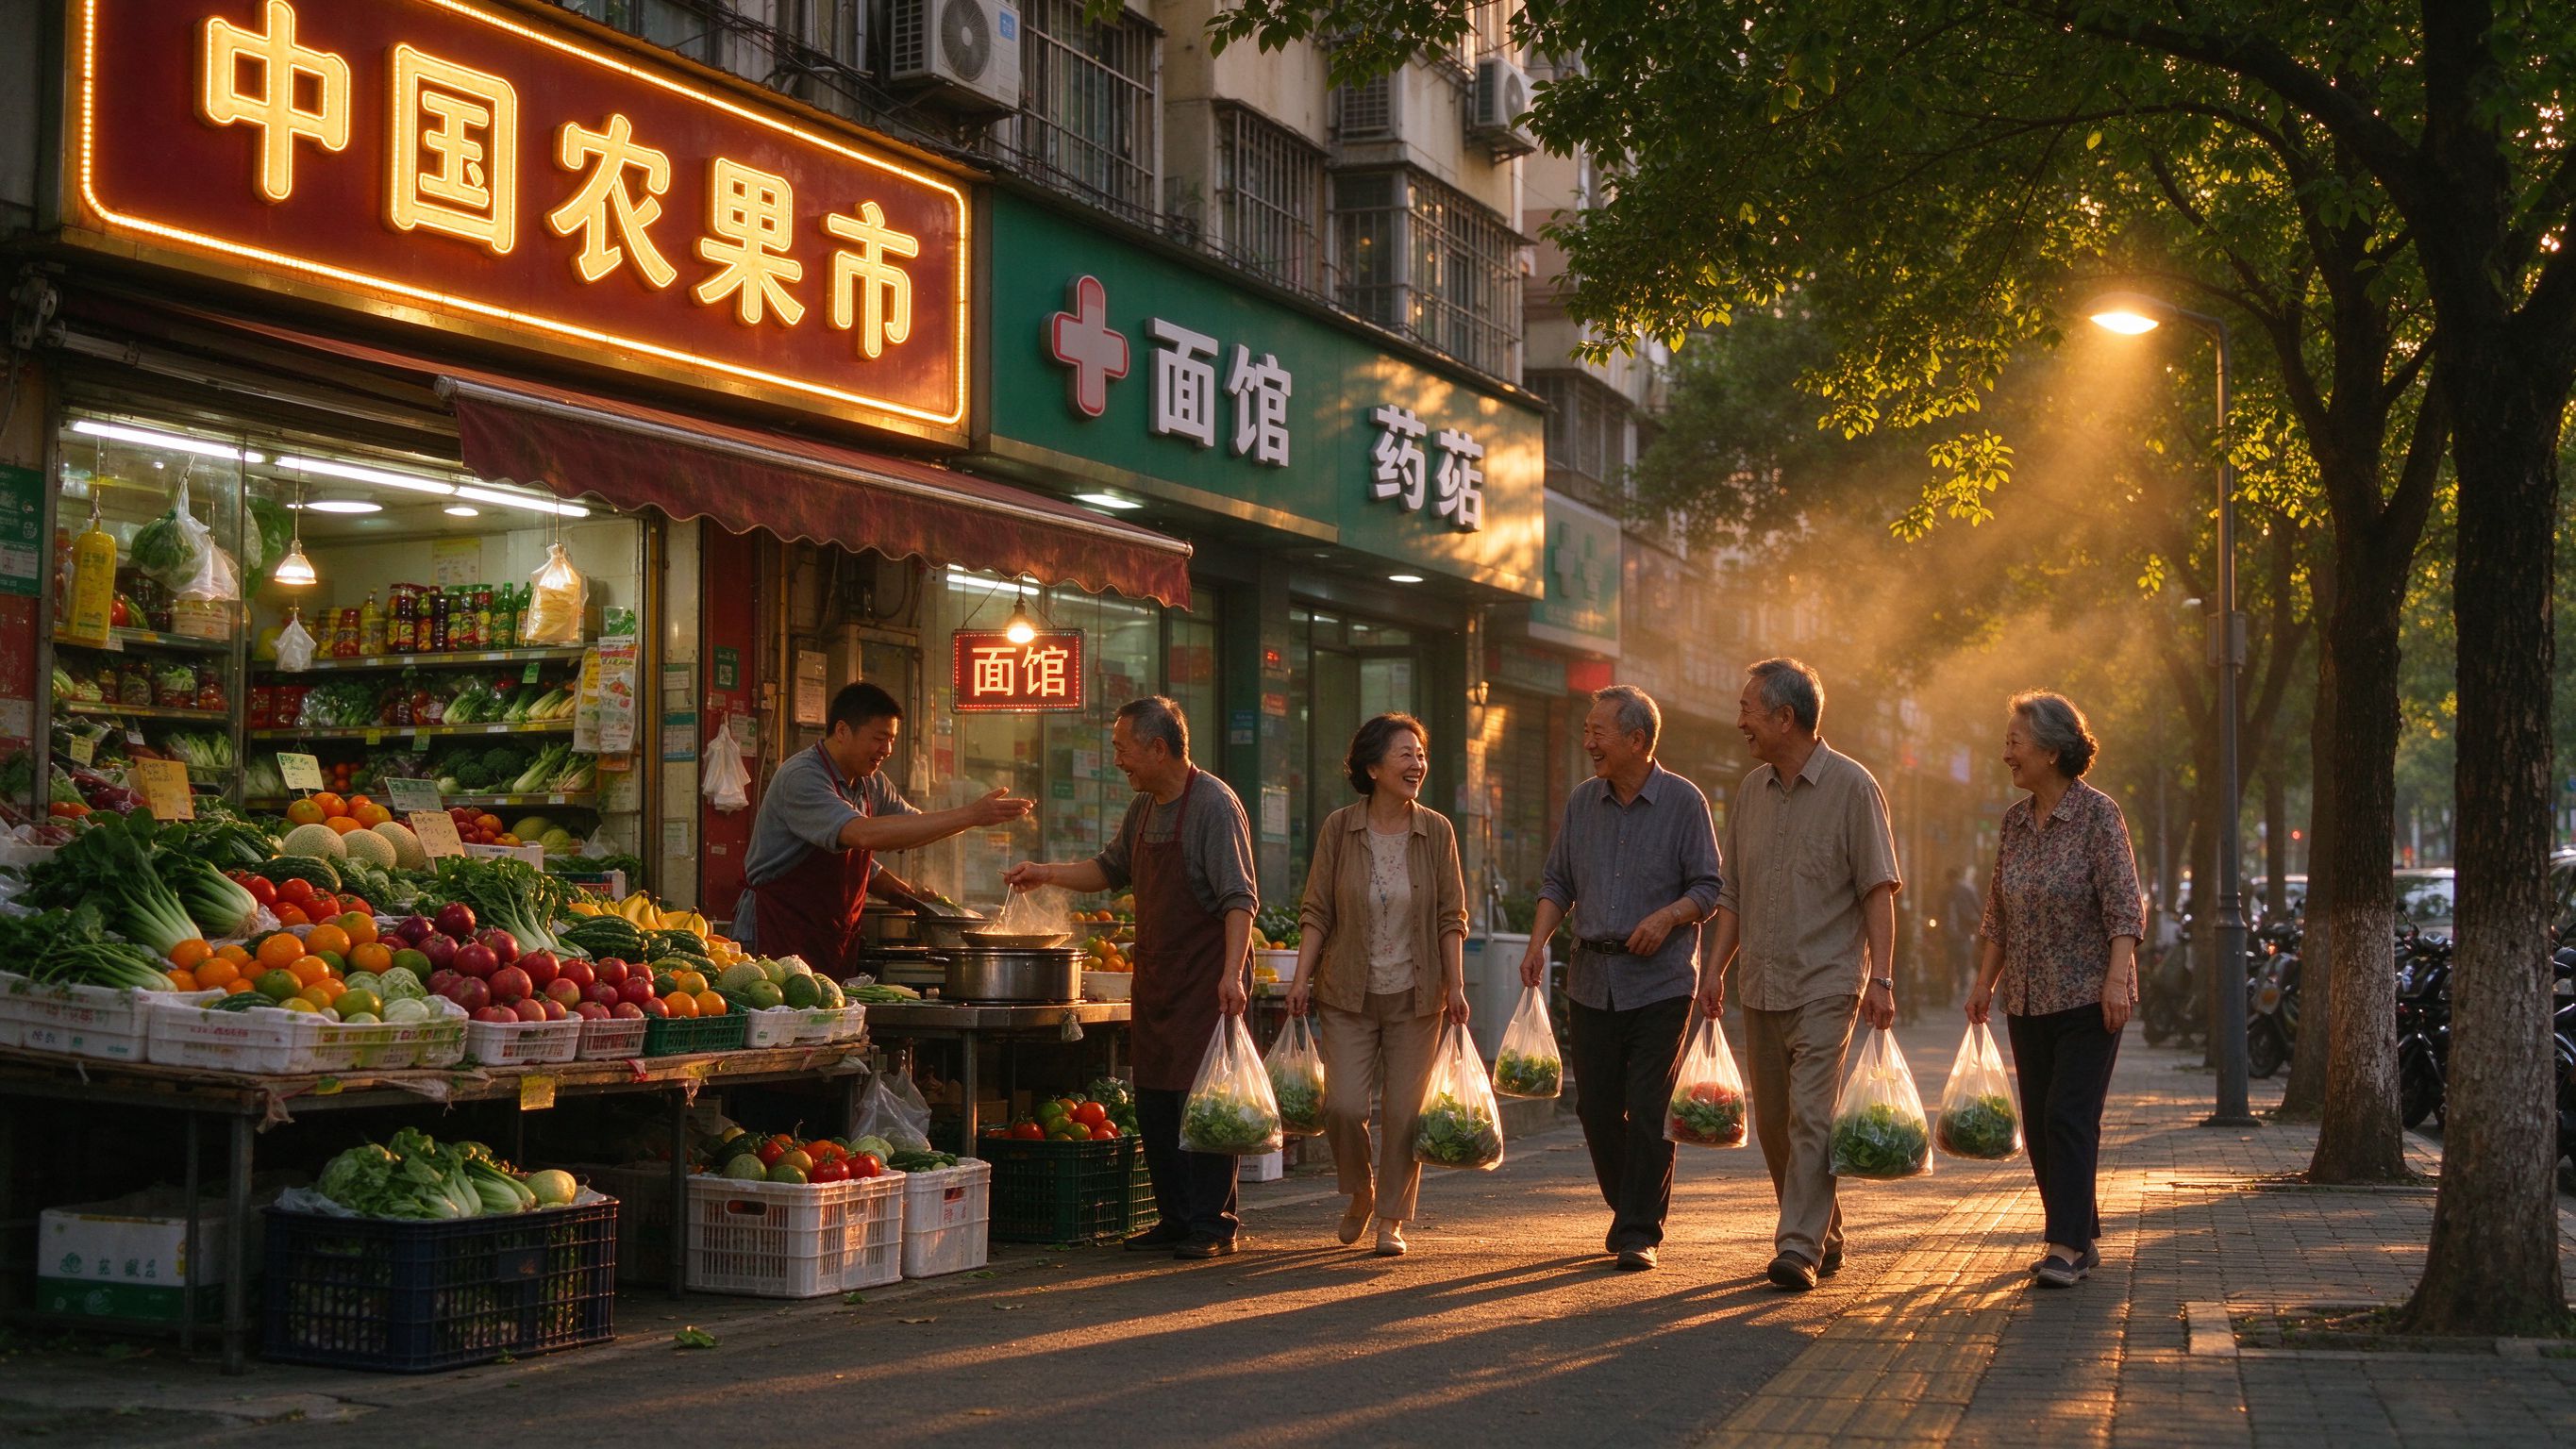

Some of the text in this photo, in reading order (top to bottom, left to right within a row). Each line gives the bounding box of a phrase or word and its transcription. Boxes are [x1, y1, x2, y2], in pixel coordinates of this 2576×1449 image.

[202, 0, 919, 358] 中国农果市
[1147, 317, 1292, 467] 面馆
[972, 645, 1069, 697] 面馆
